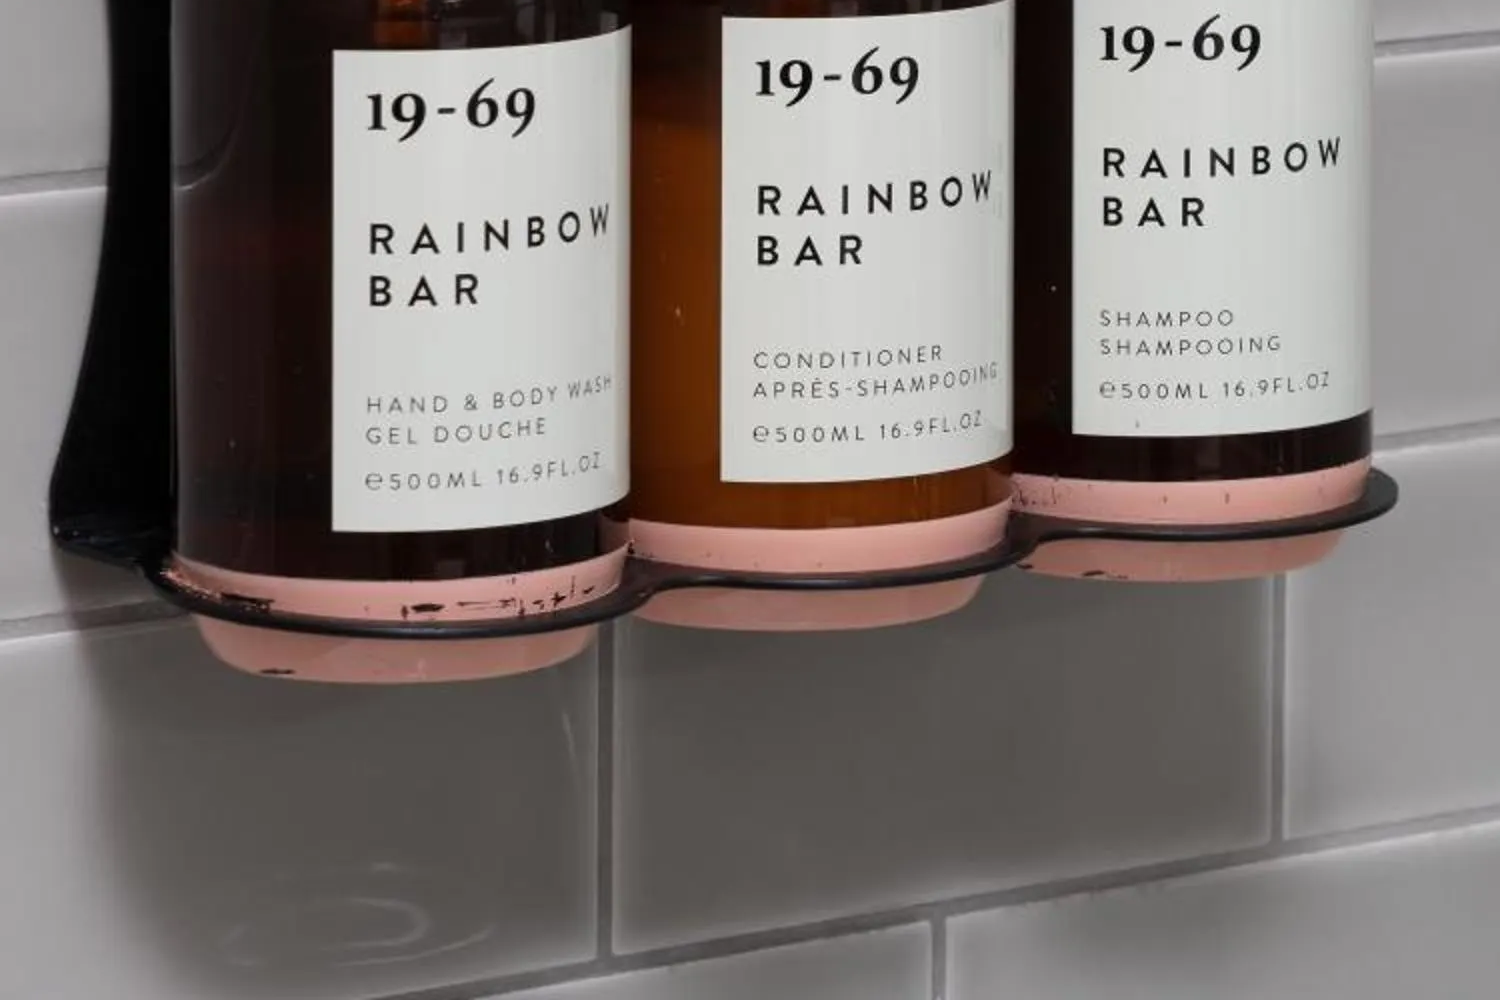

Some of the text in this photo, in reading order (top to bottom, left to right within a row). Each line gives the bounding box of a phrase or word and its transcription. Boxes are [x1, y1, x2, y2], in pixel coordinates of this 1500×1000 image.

[1099, 13, 1261, 73] 19-69
[755, 45, 920, 108] 19-69
[367, 77, 536, 143] 19-69
[1103, 136, 1341, 180] RAINBOW
[757, 169, 992, 217] RAINBOW
[369, 203, 609, 256] RAINBOW
[1102, 196, 1205, 228] BAR
[757, 234, 863, 267] BAR
[369, 273, 479, 308] BAR
[1099, 309, 1234, 329] SHAMPOO
[752, 345, 943, 369] CONDITIONER
[1099, 334, 1281, 357] SHAMPOOING
[366, 375, 612, 415] HAND & BODY WASH
[364, 417, 546, 446] GEL DOUCHE
